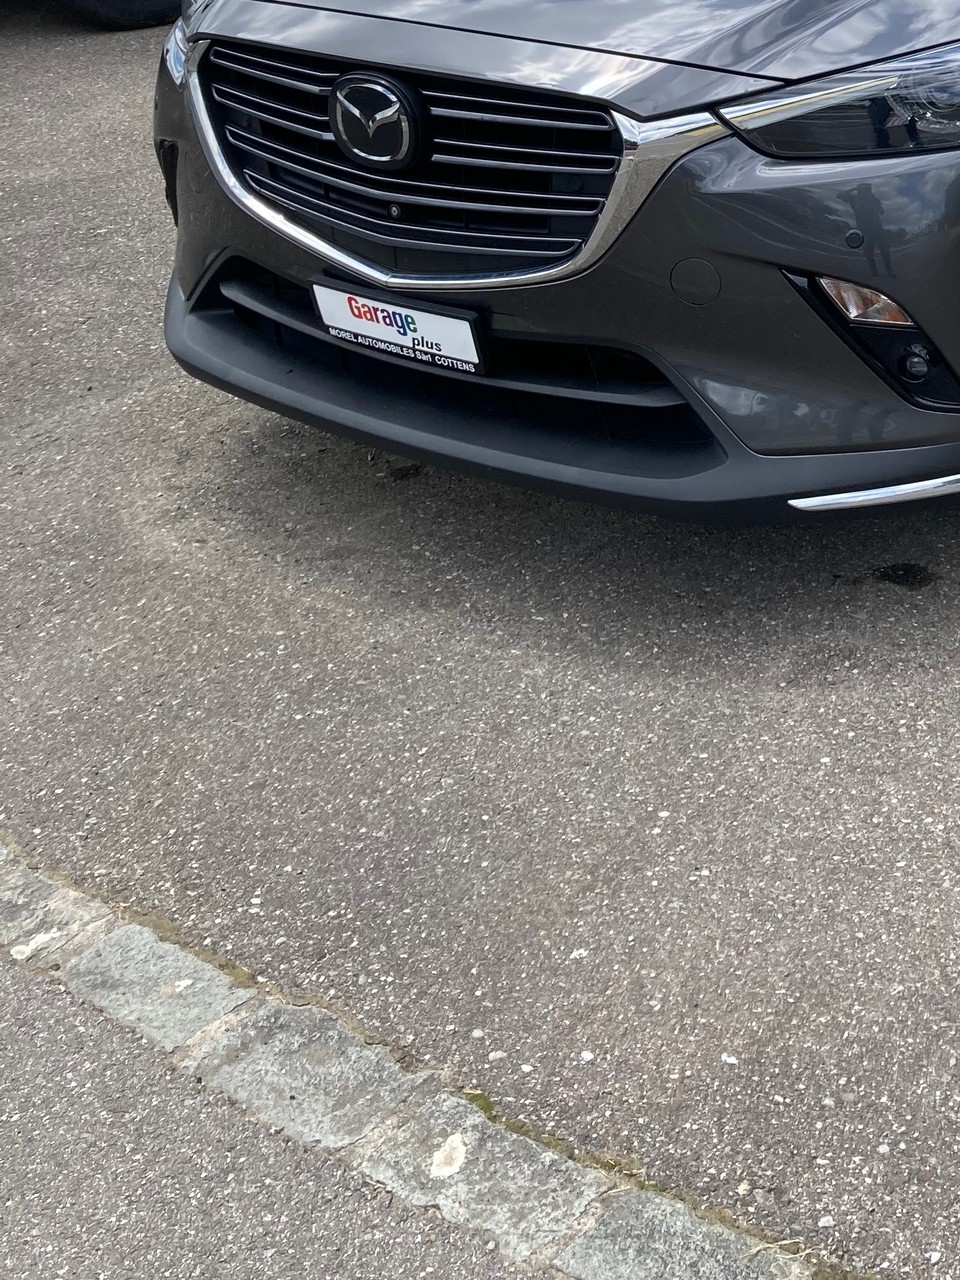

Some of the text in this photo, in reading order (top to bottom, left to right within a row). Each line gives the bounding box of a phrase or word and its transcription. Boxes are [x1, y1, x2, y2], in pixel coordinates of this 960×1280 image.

[347, 296, 417, 336] Garage
[329, 328, 357, 342] MOREL
[358, 335, 414, 357] AUTOMOBILES
[435, 356, 475, 372] COTTENS
[412, 336, 442, 352] plus
